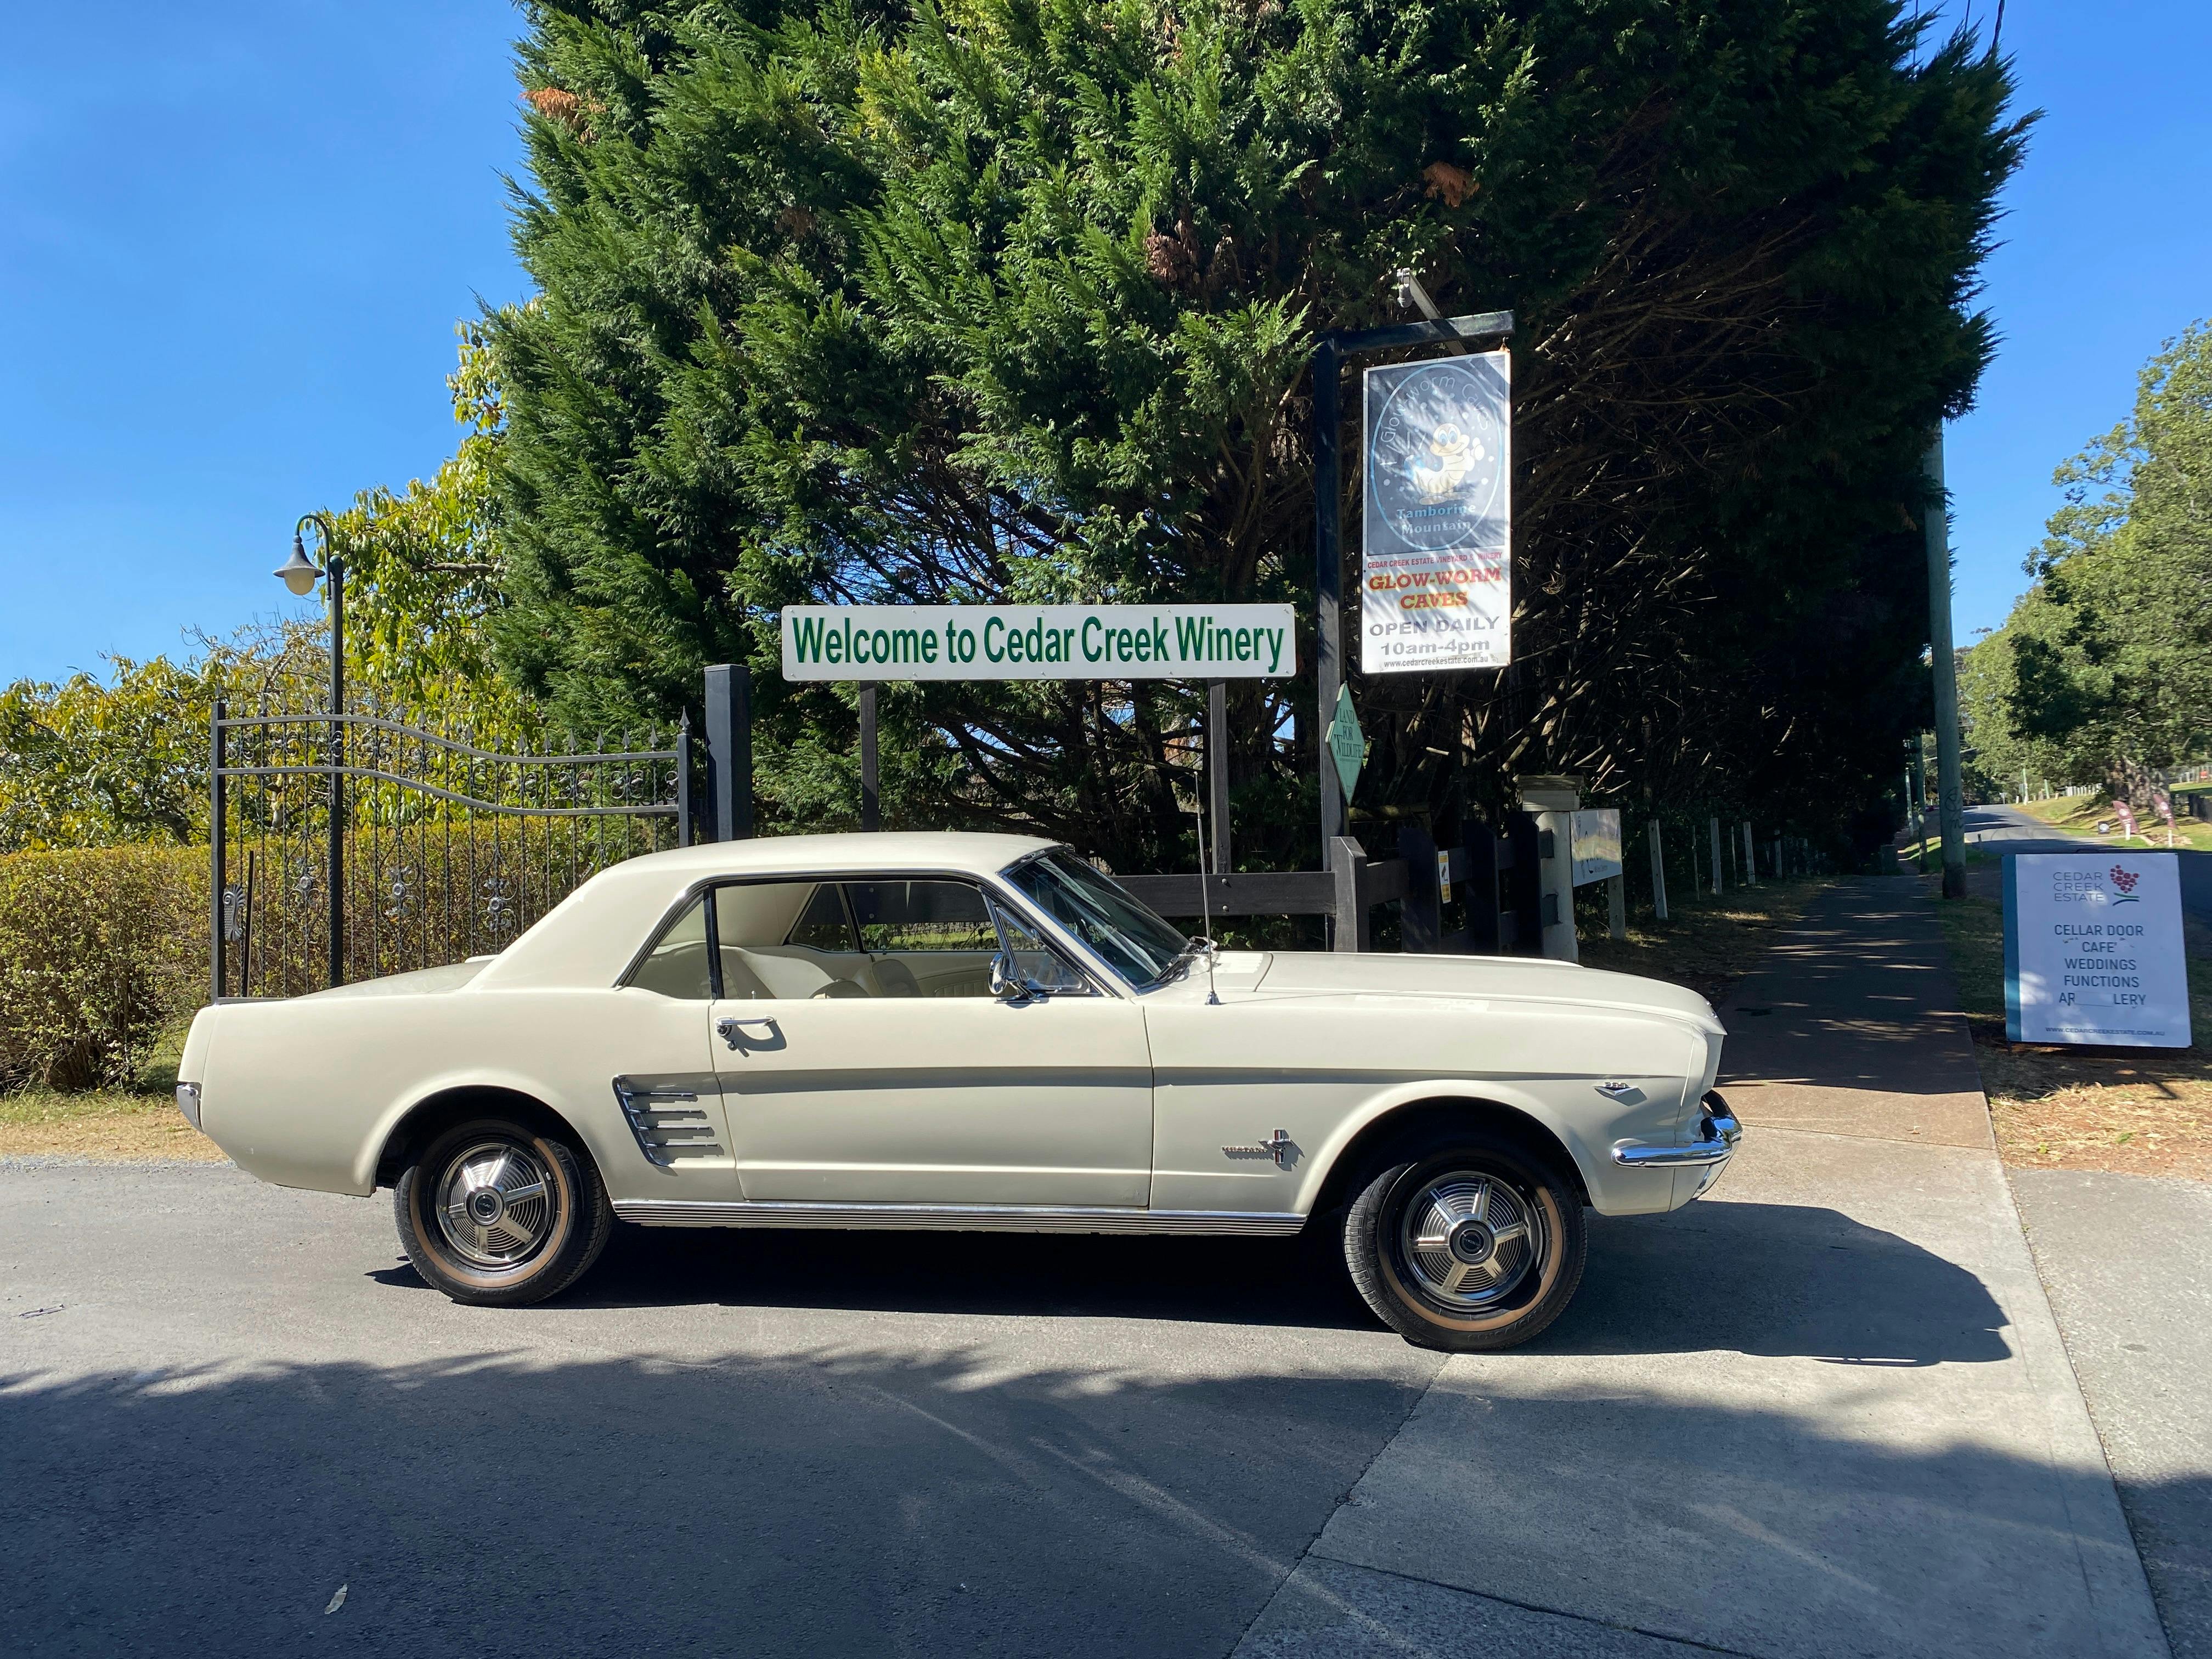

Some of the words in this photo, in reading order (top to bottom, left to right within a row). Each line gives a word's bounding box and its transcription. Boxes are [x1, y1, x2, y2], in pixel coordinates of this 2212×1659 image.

[1397, 504, 1476, 519] Tamborine
[1402, 519, 1471, 534] Mountain
[1436, 555, 1468, 563] VINEYARD
[1478, 552, 1502, 560] WINERY
[1369, 567, 1502, 590] GLOW-WORM
[1400, 591, 1469, 609] CAVES
[1369, 620, 1427, 636] OPEN
[1435, 616, 1500, 633] DAILY
[792, 617, 938, 664] Welcome
[946, 619, 975, 663] to
[983, 616, 1076, 663] Cedar
[1081, 616, 1170, 662] Creek
[1174, 616, 1284, 673] Winery
[1381, 639, 1490, 656] 10am-4pm
[1384, 656, 1488, 668] www.cedarcreekestate.com.au
[1340, 708, 1355, 725] LAND
[1343, 726, 1353, 741] FOR
[1334, 734, 1362, 758] WILDLIFE
[2053, 872, 2103, 881] CEDAR
[2053, 883, 2104, 891] CREEK
[2054, 893, 2105, 902] ESTATE
[2054, 924, 2103, 936] CELLAR
[2107, 925, 2144, 936] DOOR
[2064, 958, 2137, 970] WEDDINGS
[2064, 975, 2139, 988] FUNCTIONS
[2045, 1027, 2165, 1036] WWW.CEDARCREEKESTATE.COM.AU
[1221, 1145, 1268, 1153] MUSTANG
